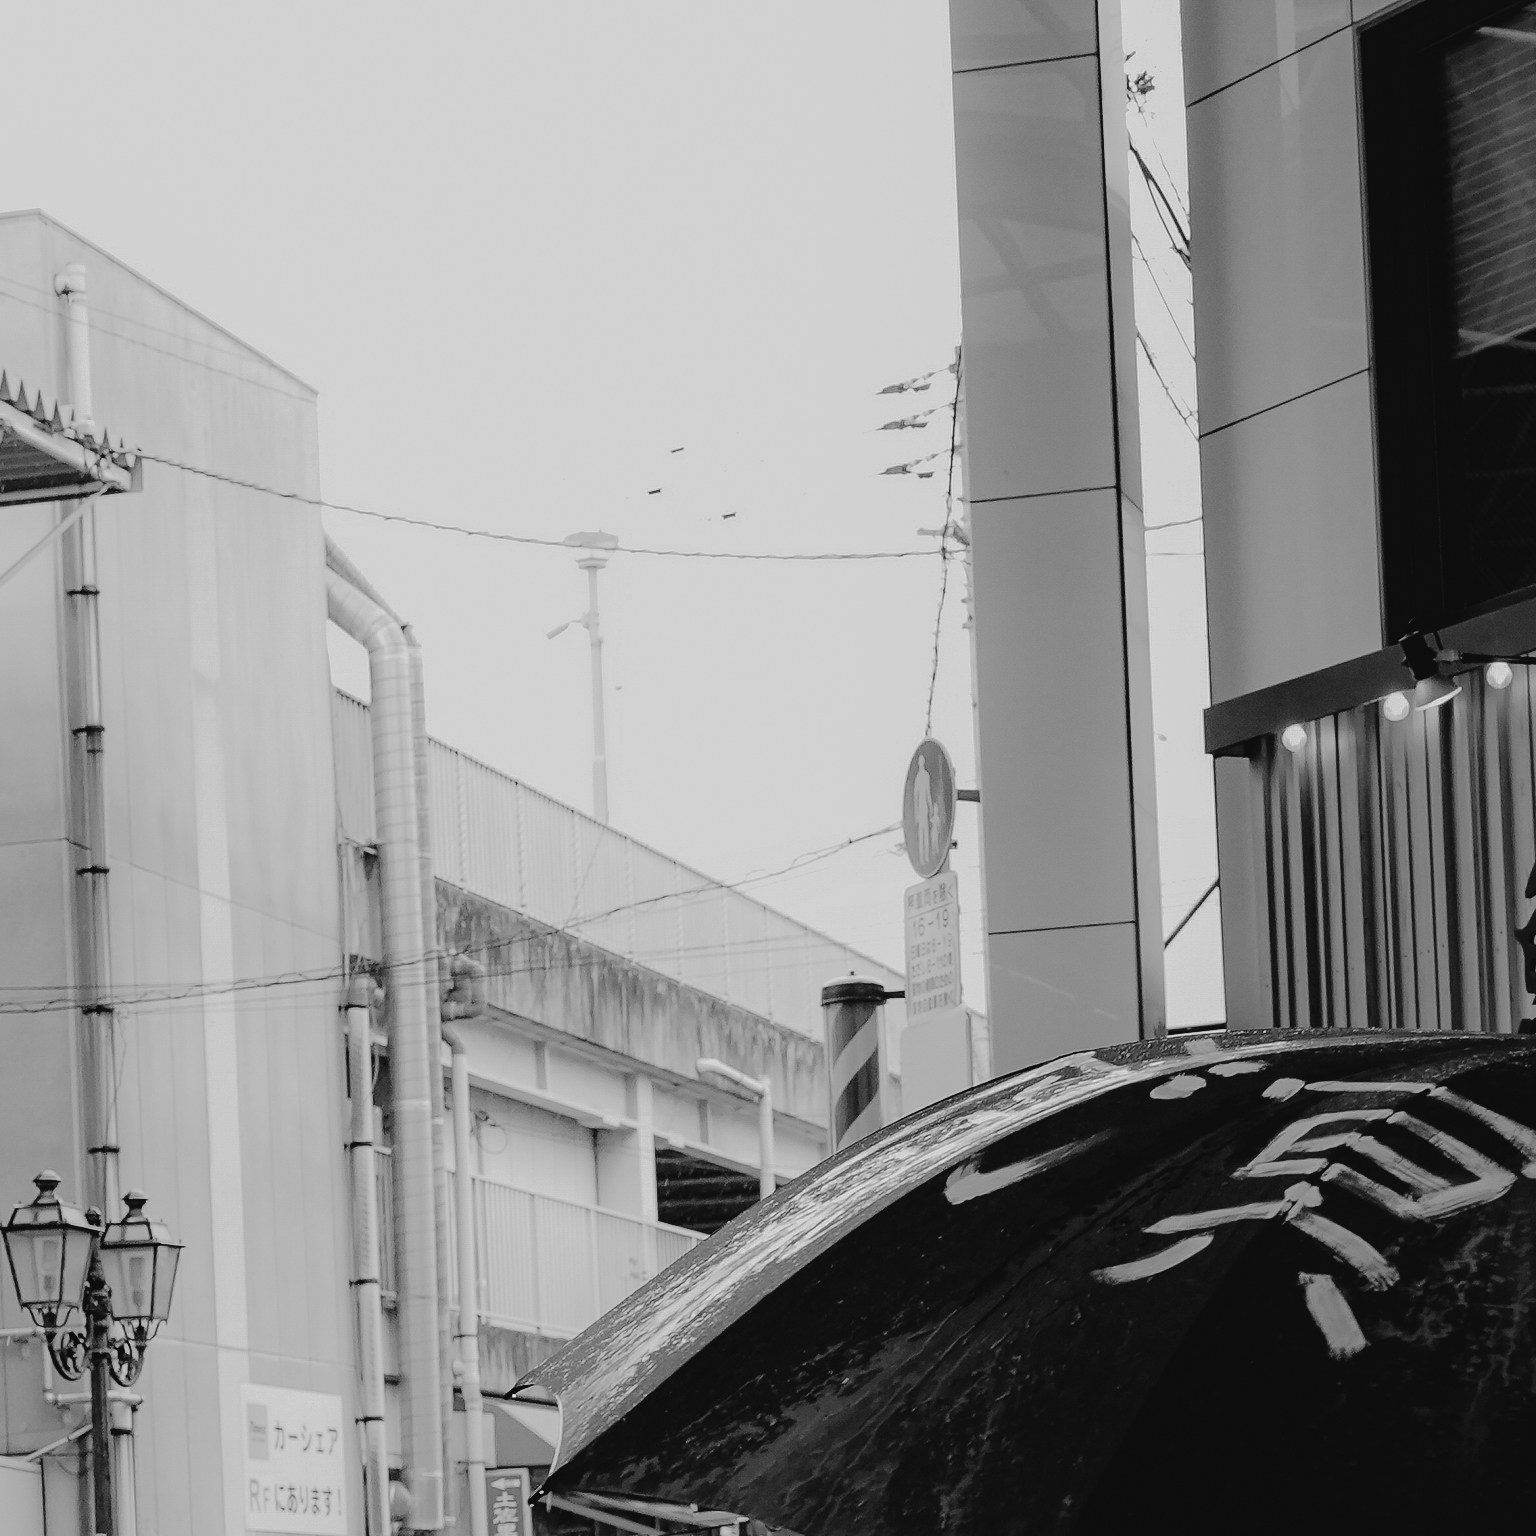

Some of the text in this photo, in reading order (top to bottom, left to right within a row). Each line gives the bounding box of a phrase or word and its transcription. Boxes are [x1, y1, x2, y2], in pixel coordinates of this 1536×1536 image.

[275, 1421, 338, 1456] カーシェア
